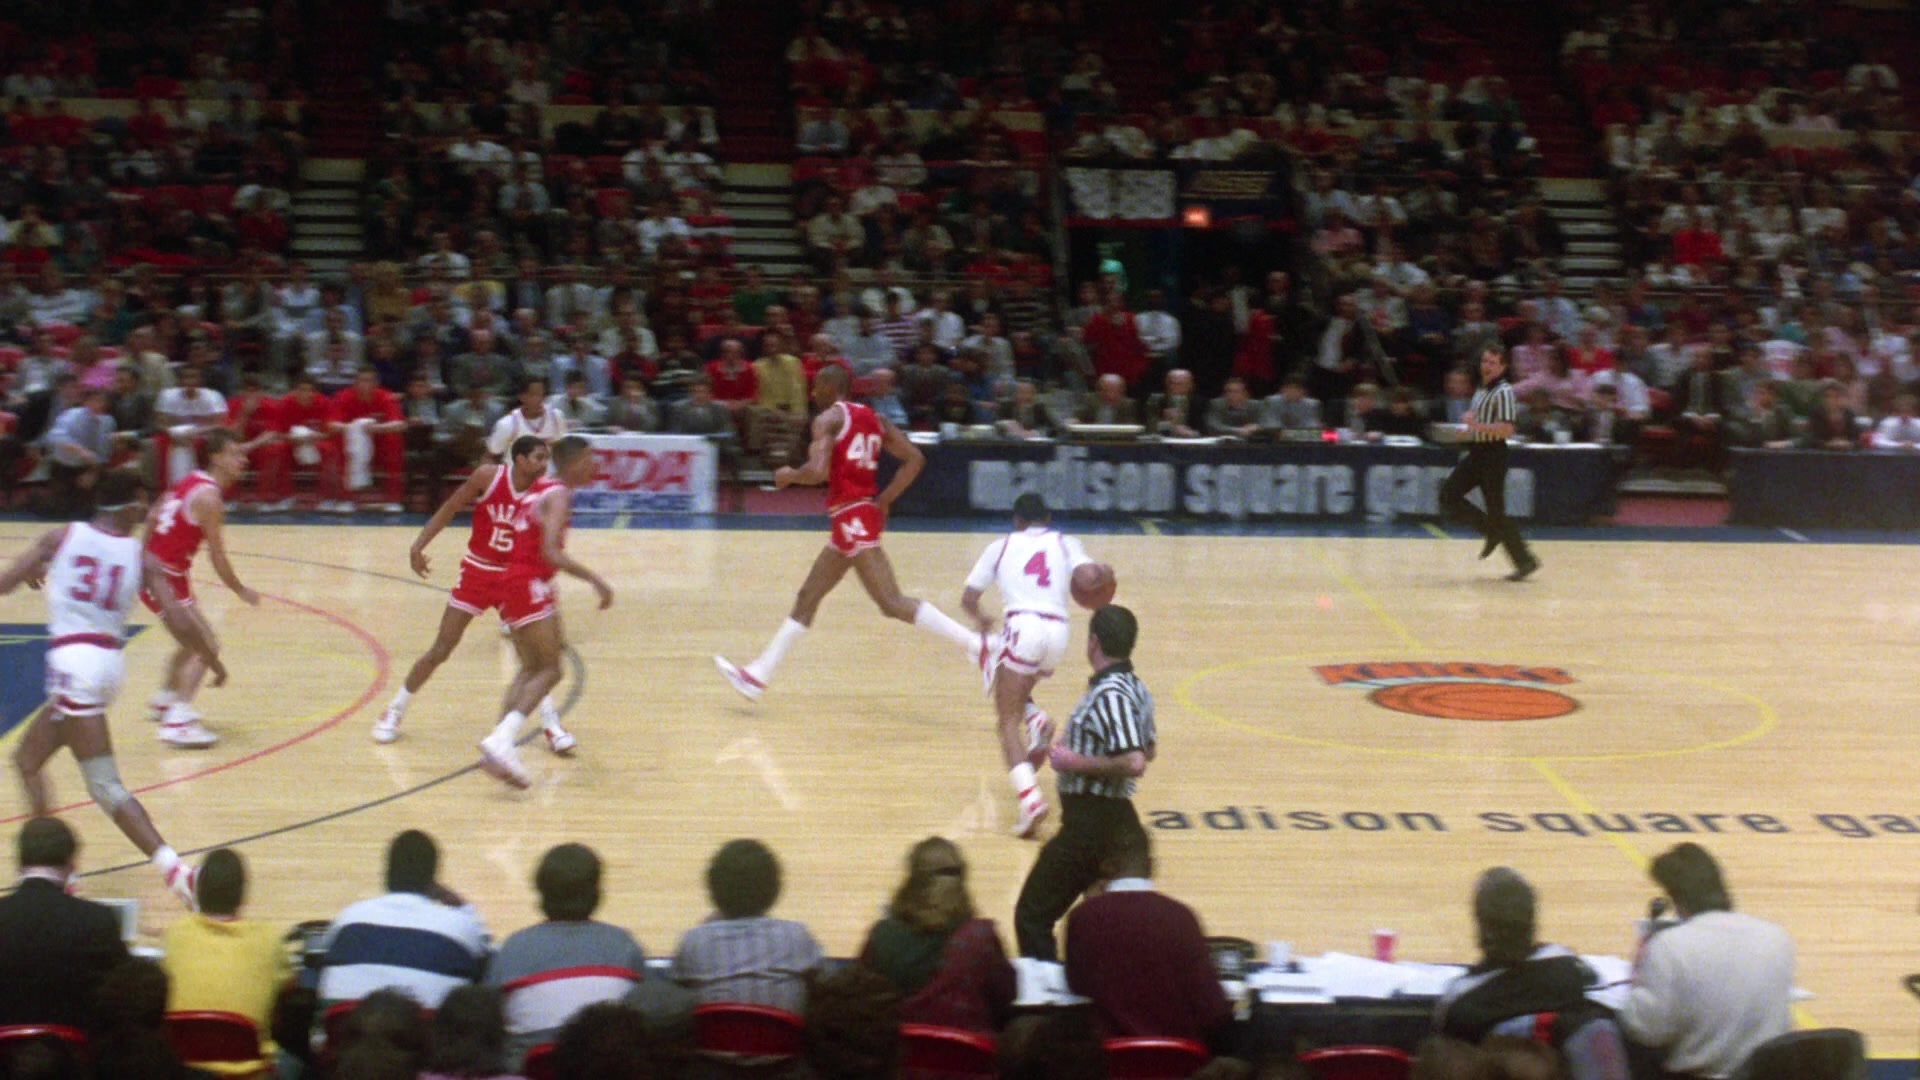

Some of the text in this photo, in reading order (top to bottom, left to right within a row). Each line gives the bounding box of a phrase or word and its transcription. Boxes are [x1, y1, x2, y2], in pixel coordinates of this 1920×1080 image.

[846, 432, 882, 470] 40
[1182, 463, 1355, 517] square
[1365, 464, 1535, 522] garn
[488, 526, 514, 552] 15
[70, 555, 126, 612] 31
[1024, 551, 1051, 587] 4
[1148, 805, 1920, 838] adison square ga
